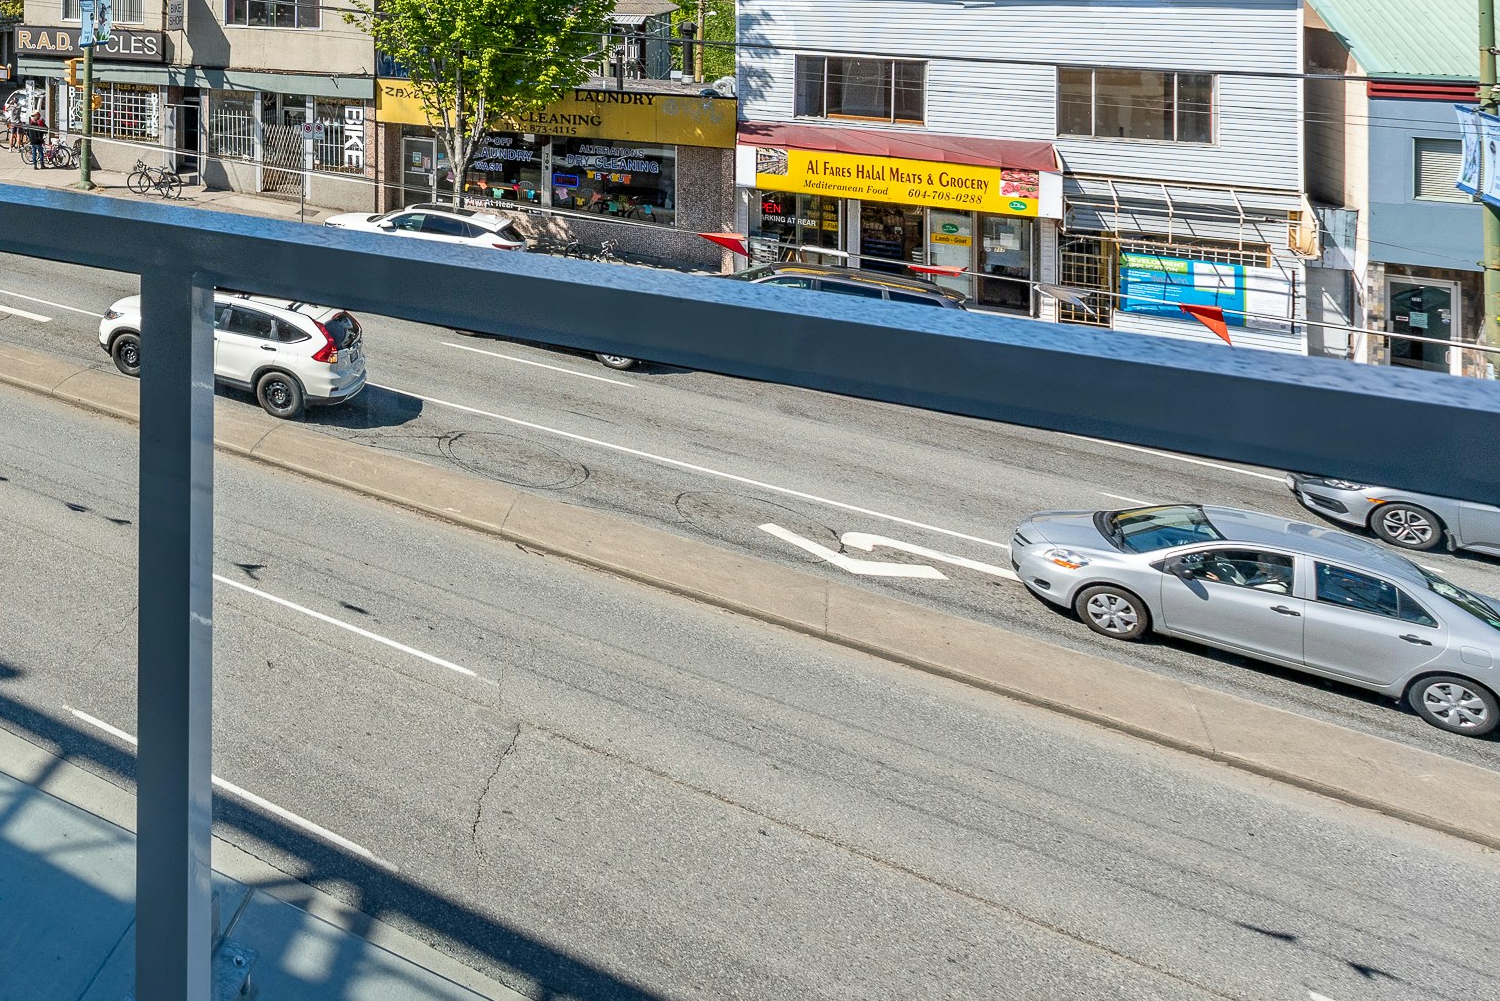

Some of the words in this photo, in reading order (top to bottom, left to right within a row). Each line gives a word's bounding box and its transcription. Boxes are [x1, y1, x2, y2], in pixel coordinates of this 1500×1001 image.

[170, 3, 182, 14] BIKE
[169, 15, 183, 26] SHOP
[18, 31, 73, 51] R.A.D.
[575, 89, 655, 105] LAUNDRY
[519, 112, 602, 126] CLEANING
[530, 124, 577, 135] 873-4115
[345, 106, 363, 168] BIKE
[579, 144, 645, 158] ALTERATIONS
[474, 161, 503, 171] WASH
[566, 154, 592, 167] DRY
[595, 156, 659, 174] CLEANING
[927, 173, 934, 185] &
[803, 180, 864, 193] Mediteranean
[866, 185, 889, 196] Food
[908, 188, 982, 204] 604-708-0288
[762, 202, 781, 213] PEN
[798, 219, 816, 227] REAR
[1126, 256, 1185, 268] DEVELOPMENT
[1126, 263, 1179, 273] APPLICATION
